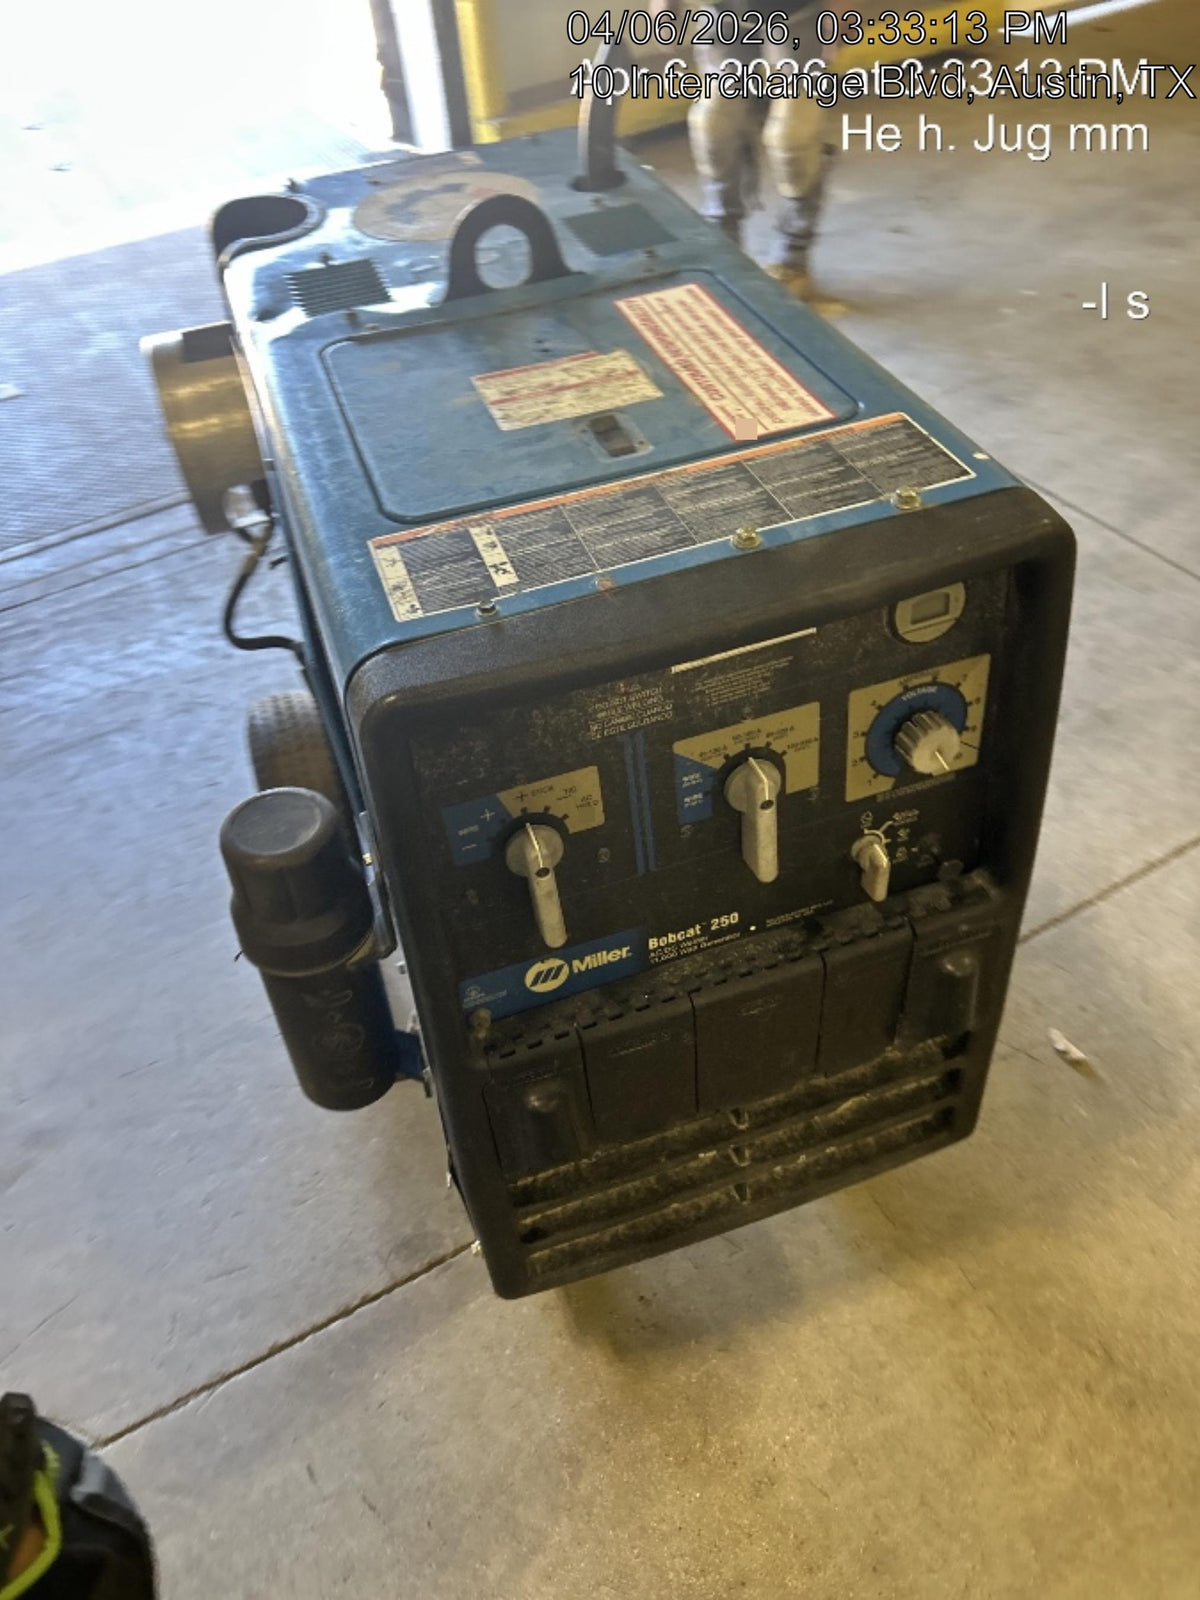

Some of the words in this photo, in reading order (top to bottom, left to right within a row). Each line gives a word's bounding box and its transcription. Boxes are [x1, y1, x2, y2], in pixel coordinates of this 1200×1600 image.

[648, 924, 702, 950] Bobcat
[710, 911, 739, 931] 250
[571, 945, 631, 973] Miller
